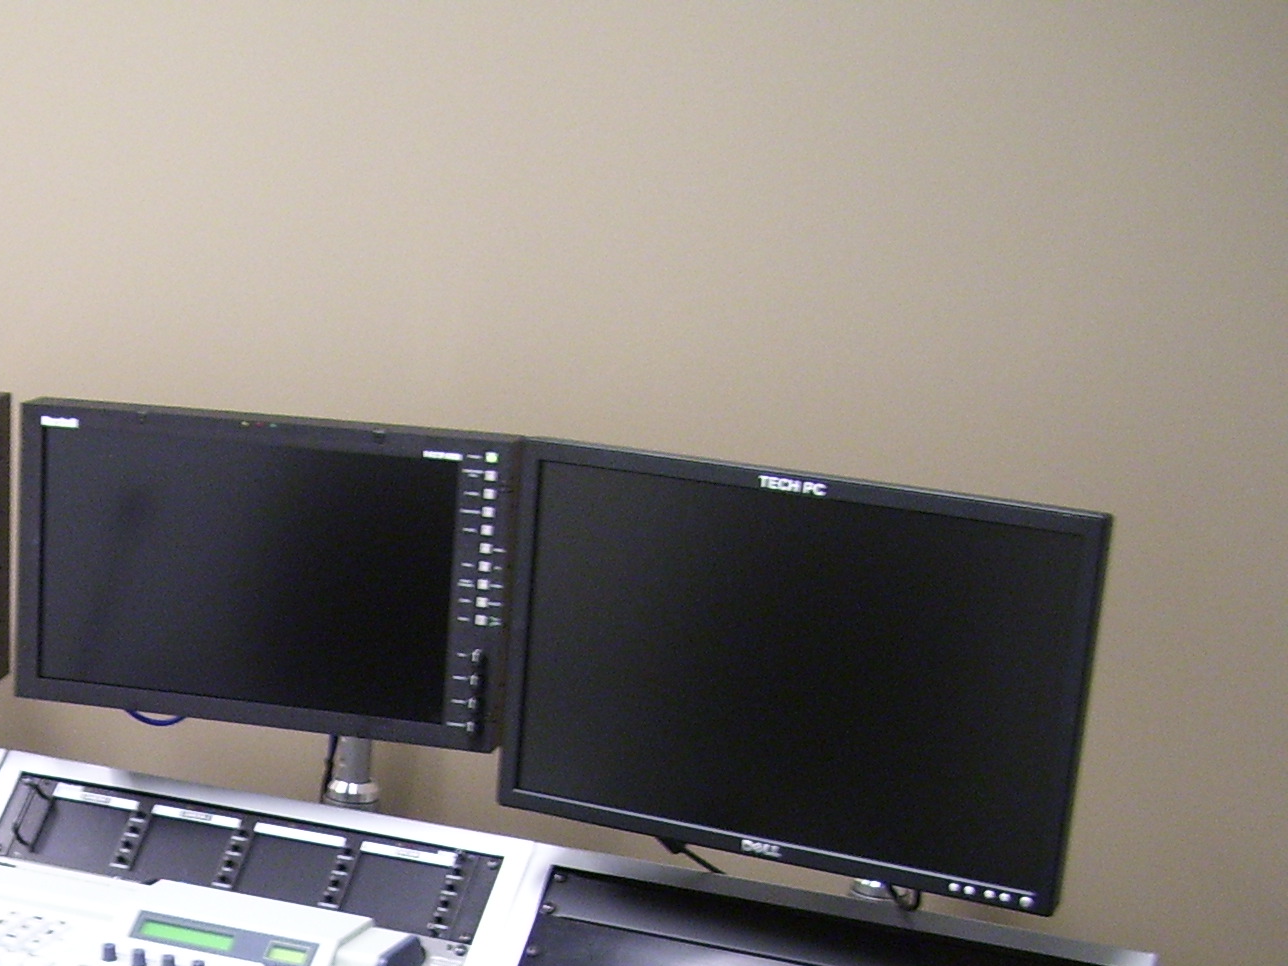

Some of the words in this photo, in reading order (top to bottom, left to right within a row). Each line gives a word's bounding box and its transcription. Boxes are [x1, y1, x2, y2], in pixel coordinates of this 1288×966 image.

[758, 475, 802, 493] TECH
[802, 481, 827, 496] PC
[741, 839, 781, 857] DELL
